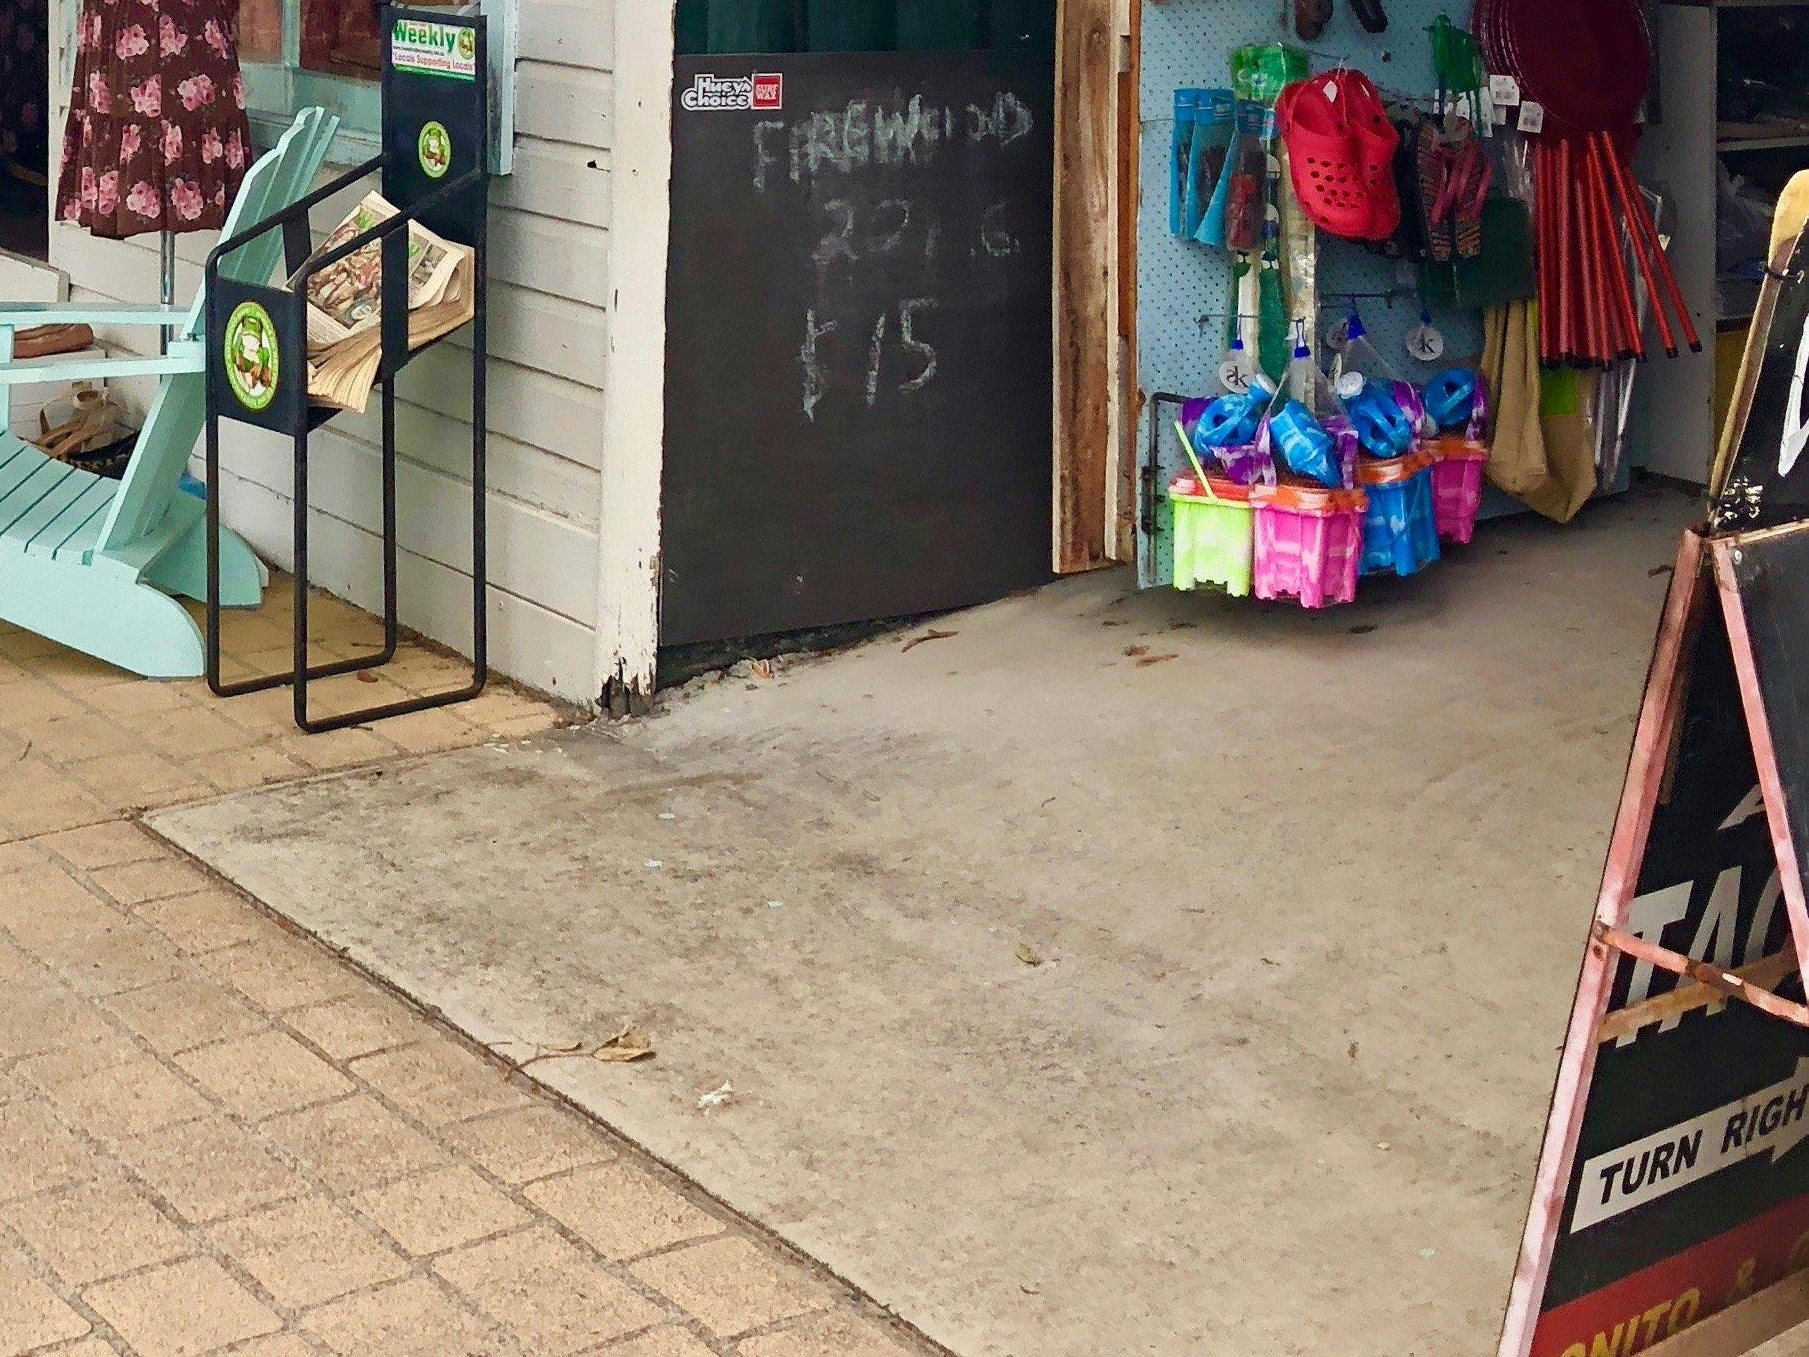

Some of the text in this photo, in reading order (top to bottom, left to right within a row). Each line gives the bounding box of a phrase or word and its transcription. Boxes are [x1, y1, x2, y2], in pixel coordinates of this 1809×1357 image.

[393, 20, 456, 54] Weekly
[684, 90, 748, 106] Choice
[1599, 1128, 1704, 1205] TURN
